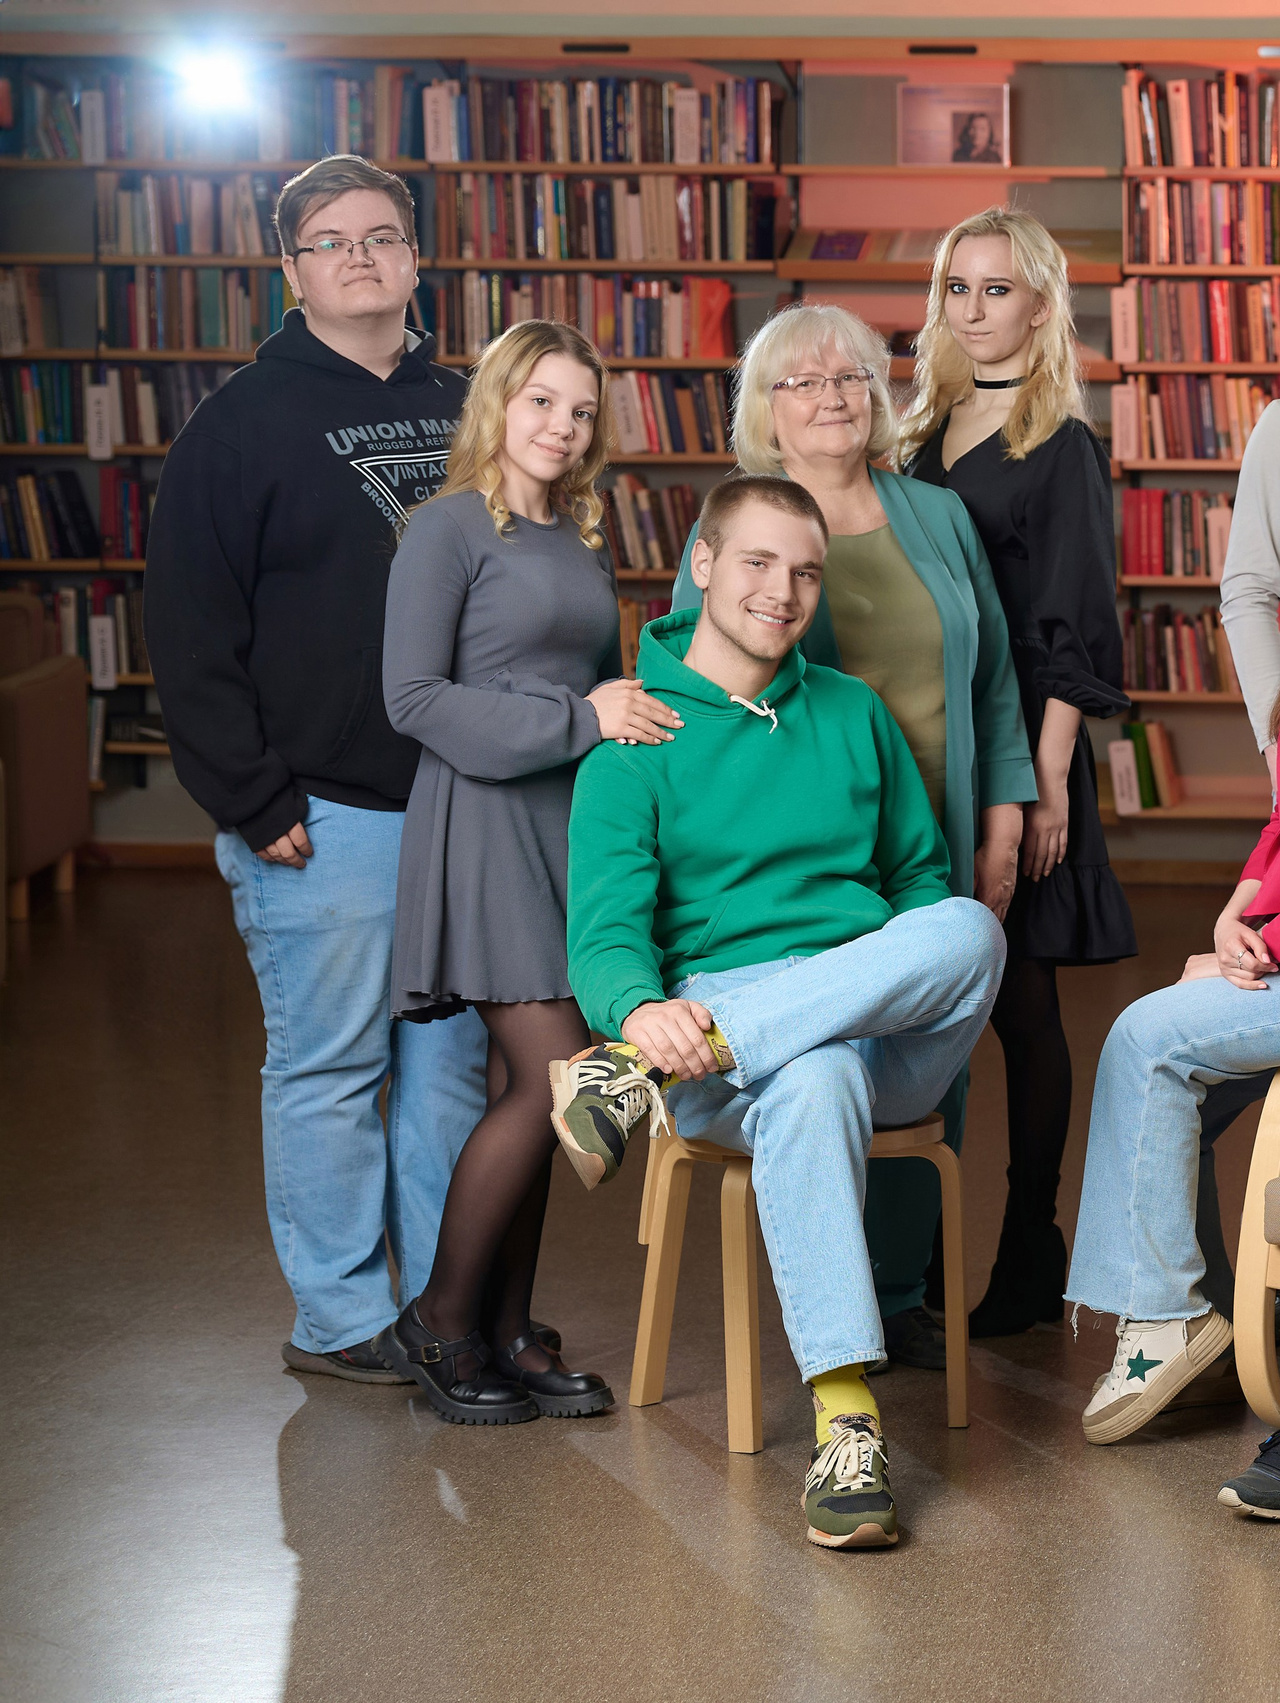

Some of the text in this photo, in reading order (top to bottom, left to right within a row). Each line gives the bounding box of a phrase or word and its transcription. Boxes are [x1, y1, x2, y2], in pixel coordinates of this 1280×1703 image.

[325, 420, 416, 455] UNION
[367, 440, 414, 452] RUGGED
[415, 438, 425, 448] &
